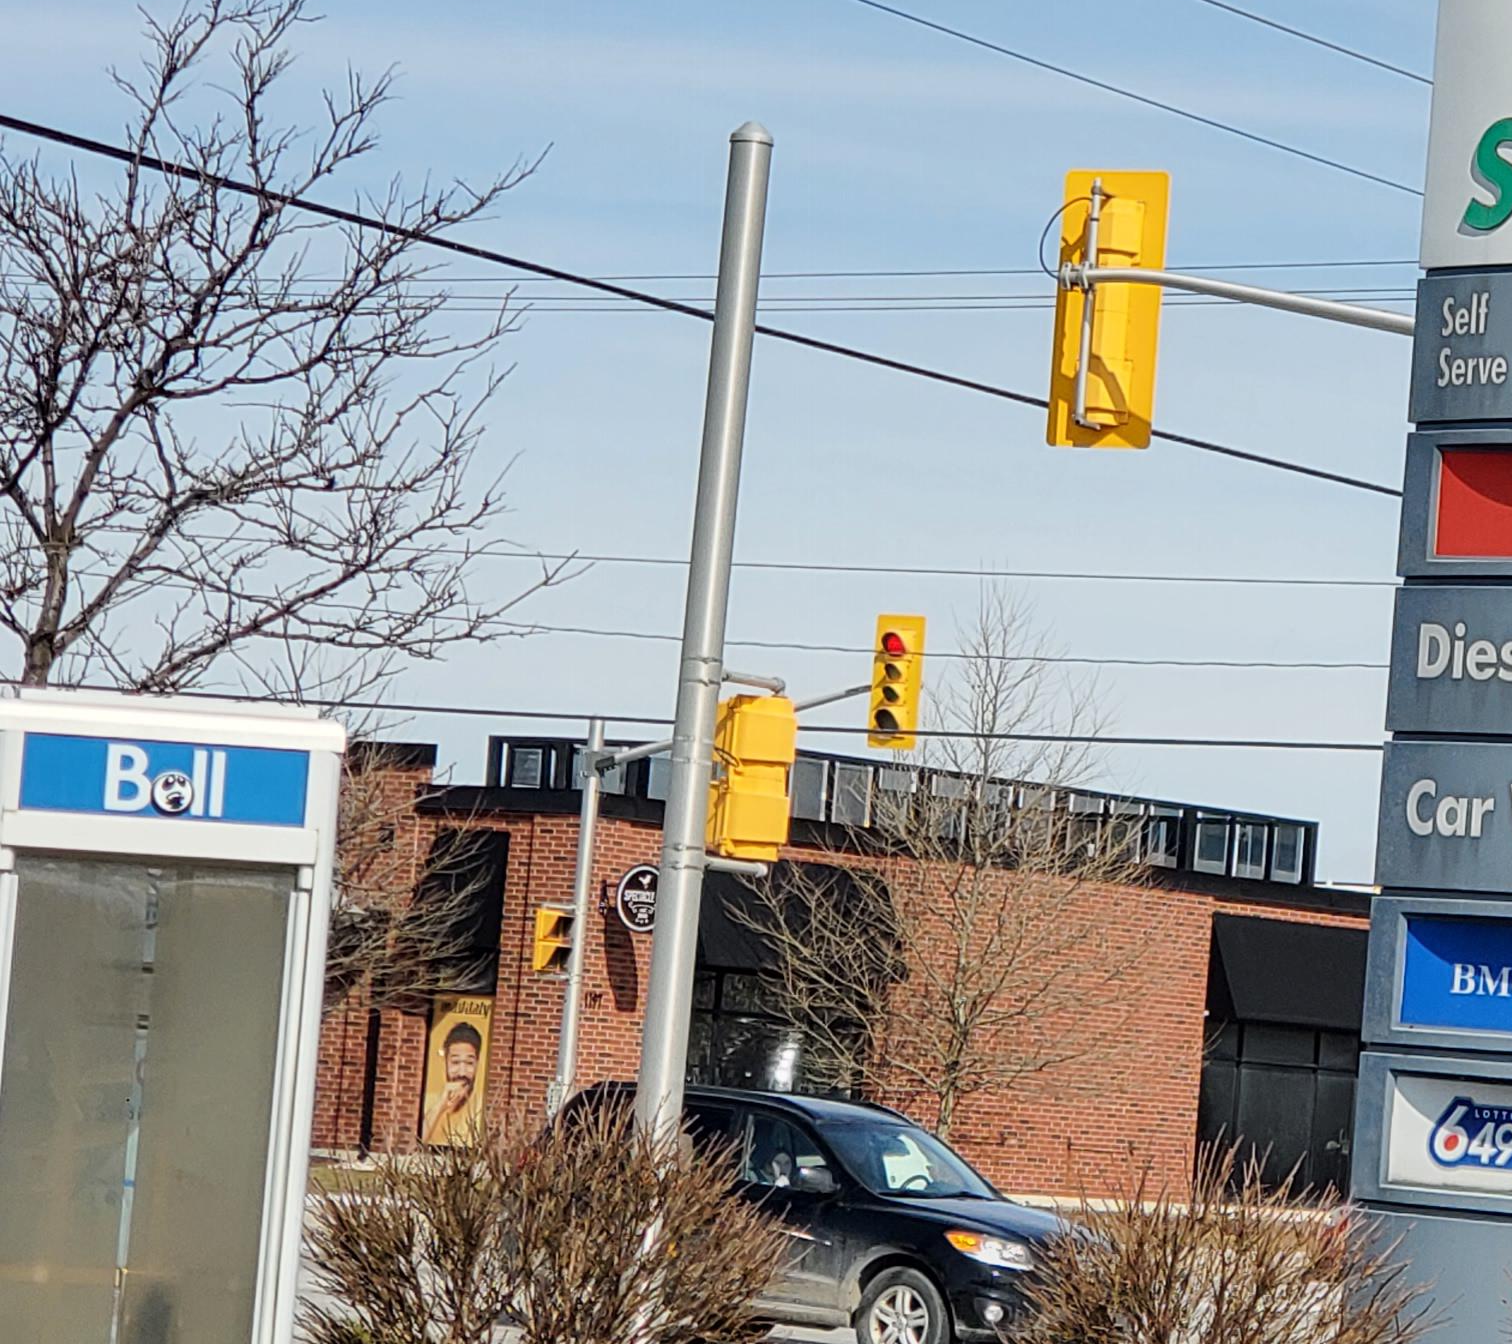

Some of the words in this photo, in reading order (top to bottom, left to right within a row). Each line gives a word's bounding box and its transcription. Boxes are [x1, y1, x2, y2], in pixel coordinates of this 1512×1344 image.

[1441, 292, 1490, 336] Self
[1437, 347, 1507, 388] Serve
[103, 743, 226, 818] Bll
[1405, 778, 1495, 839] Car
